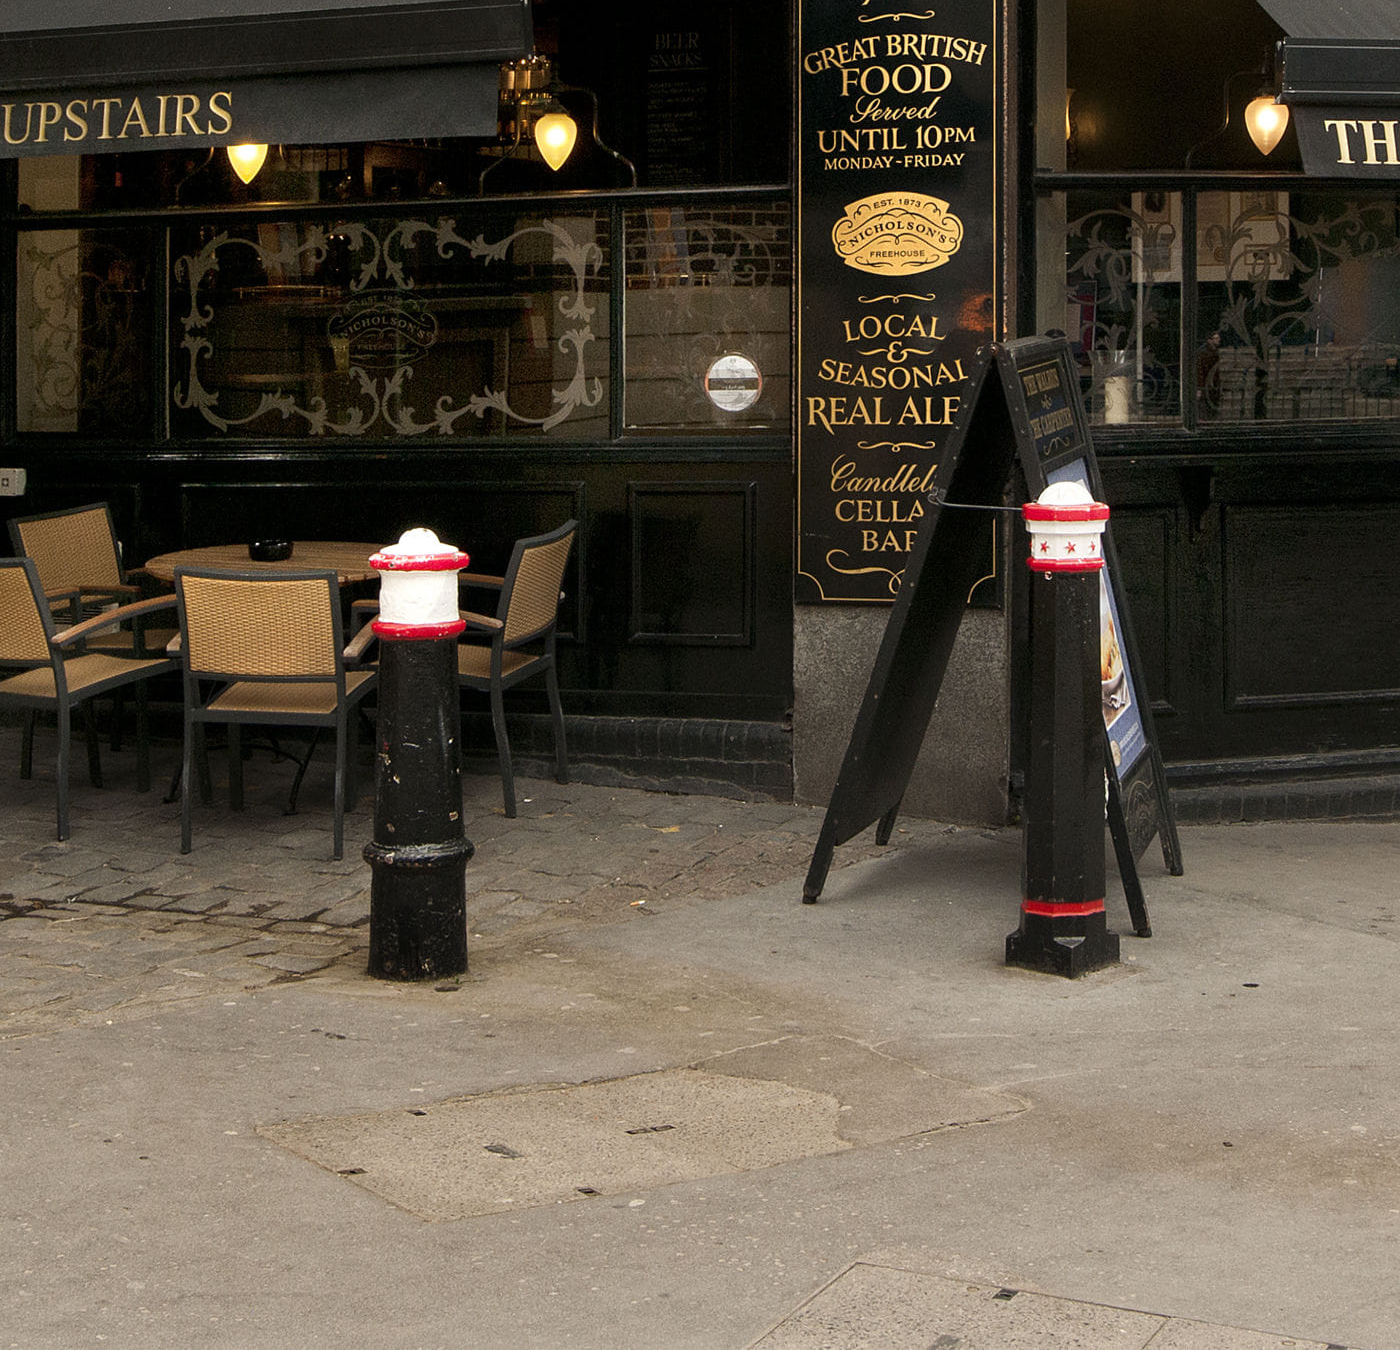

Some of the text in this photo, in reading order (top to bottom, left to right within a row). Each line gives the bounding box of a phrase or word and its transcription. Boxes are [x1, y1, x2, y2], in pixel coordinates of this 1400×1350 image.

[804, 33, 988, 75] GREAT BRITISH
[840, 63, 952, 97] FOOD
[2, 91, 233, 145] UPSTAIRS
[850, 95, 942, 124] Served
[817, 127, 908, 153] UNTIL
[873, 198, 921, 209] EST. 1873
[849, 221, 947, 248] NICHOLSON'S
[869, 249, 926, 258] FREEHOUSE
[842, 314, 947, 343] LOCAL
[817, 358, 969, 390] SEASONAL
[805, 396, 892, 435] REAL
[830, 453, 938, 493] Candlel
[835, 500, 925, 522] CELLA
